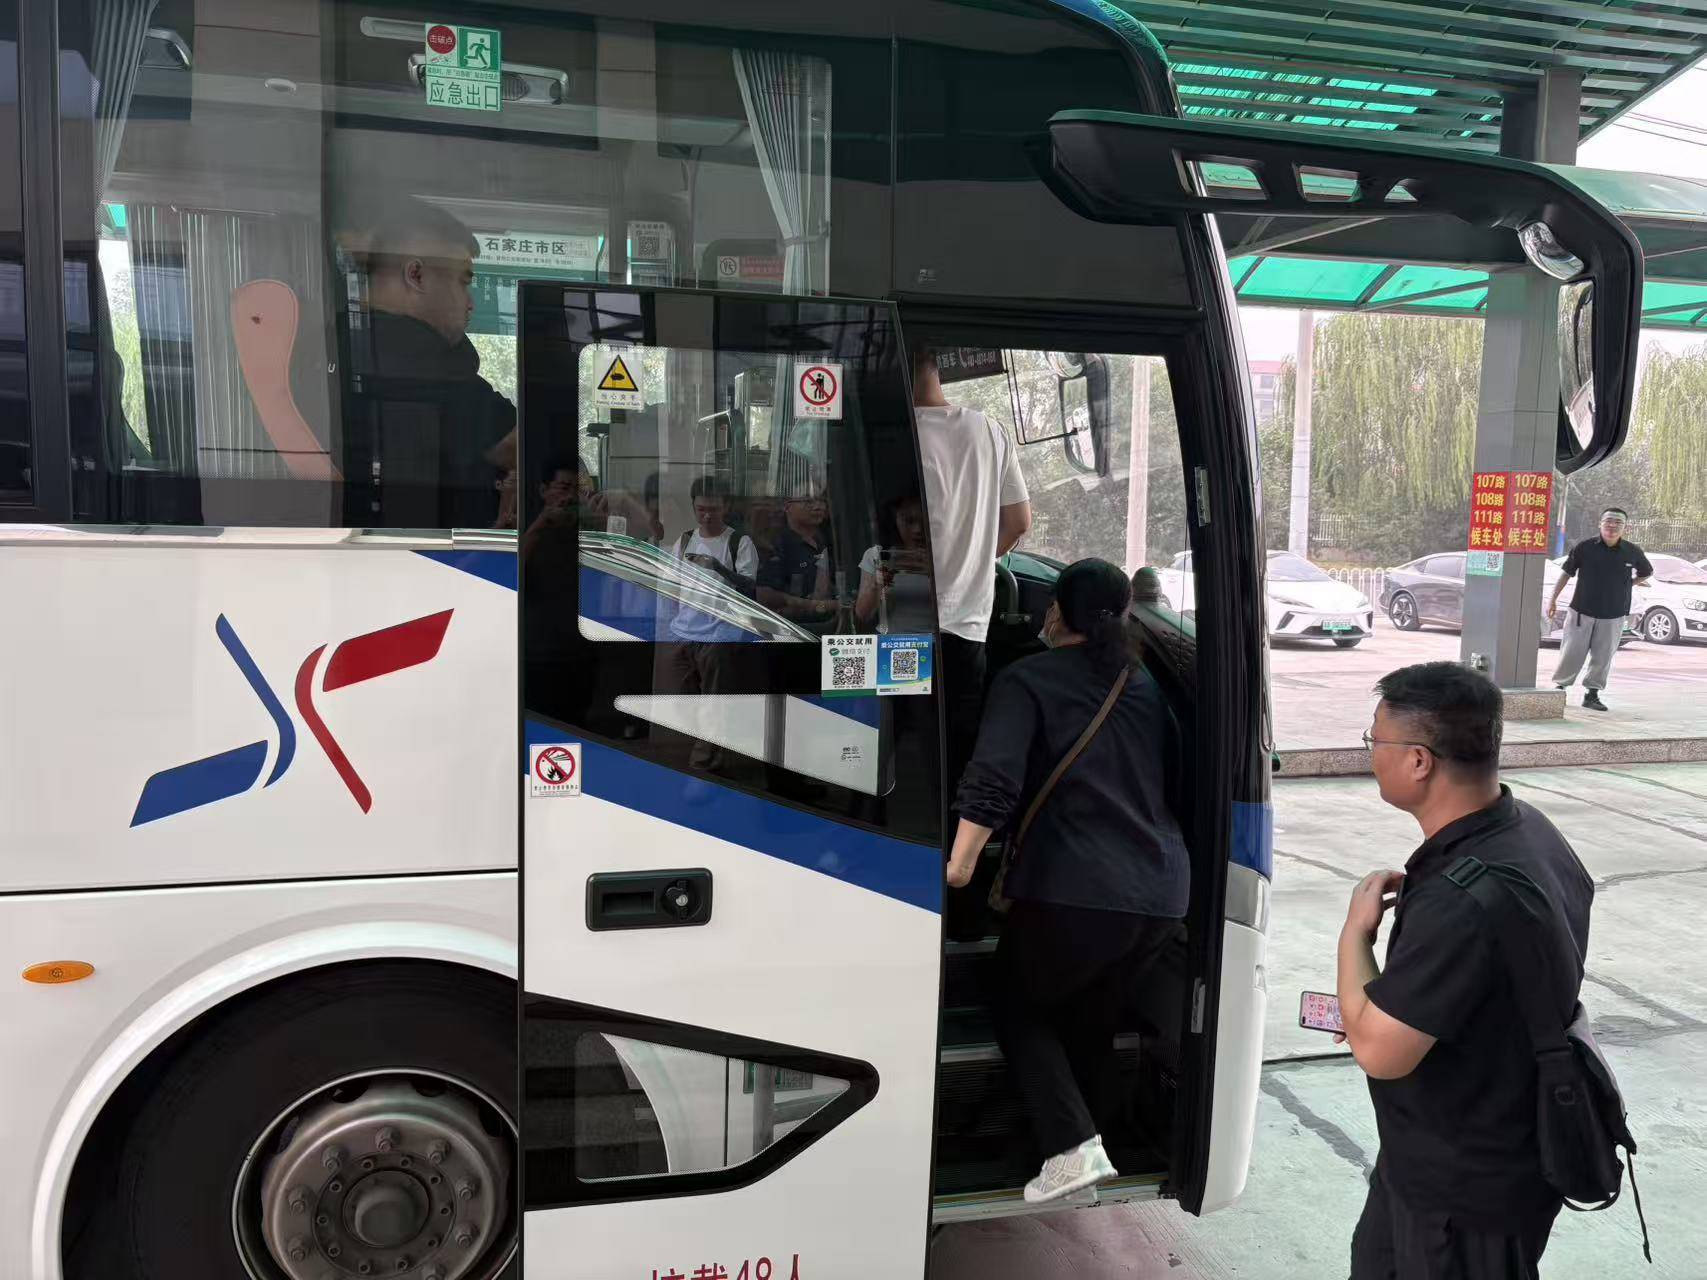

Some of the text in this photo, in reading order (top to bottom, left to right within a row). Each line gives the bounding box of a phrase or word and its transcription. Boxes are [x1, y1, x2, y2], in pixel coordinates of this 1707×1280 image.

[430, 80, 499, 110] 应急出口
[485, 237, 567, 256] 石家庄市区
[1476, 474, 1506, 489] 107路
[1515, 473, 1549, 489] 107路
[1475, 492, 1505, 507] 108路
[1513, 492, 1547, 508] 108路
[1474, 509, 1503, 525] 111路
[1512, 509, 1546, 526] 111路
[1471, 527, 1503, 546] 候车处
[1507, 527, 1546, 547] 候车处
[827, 637, 873, 646] 乘公交就用
